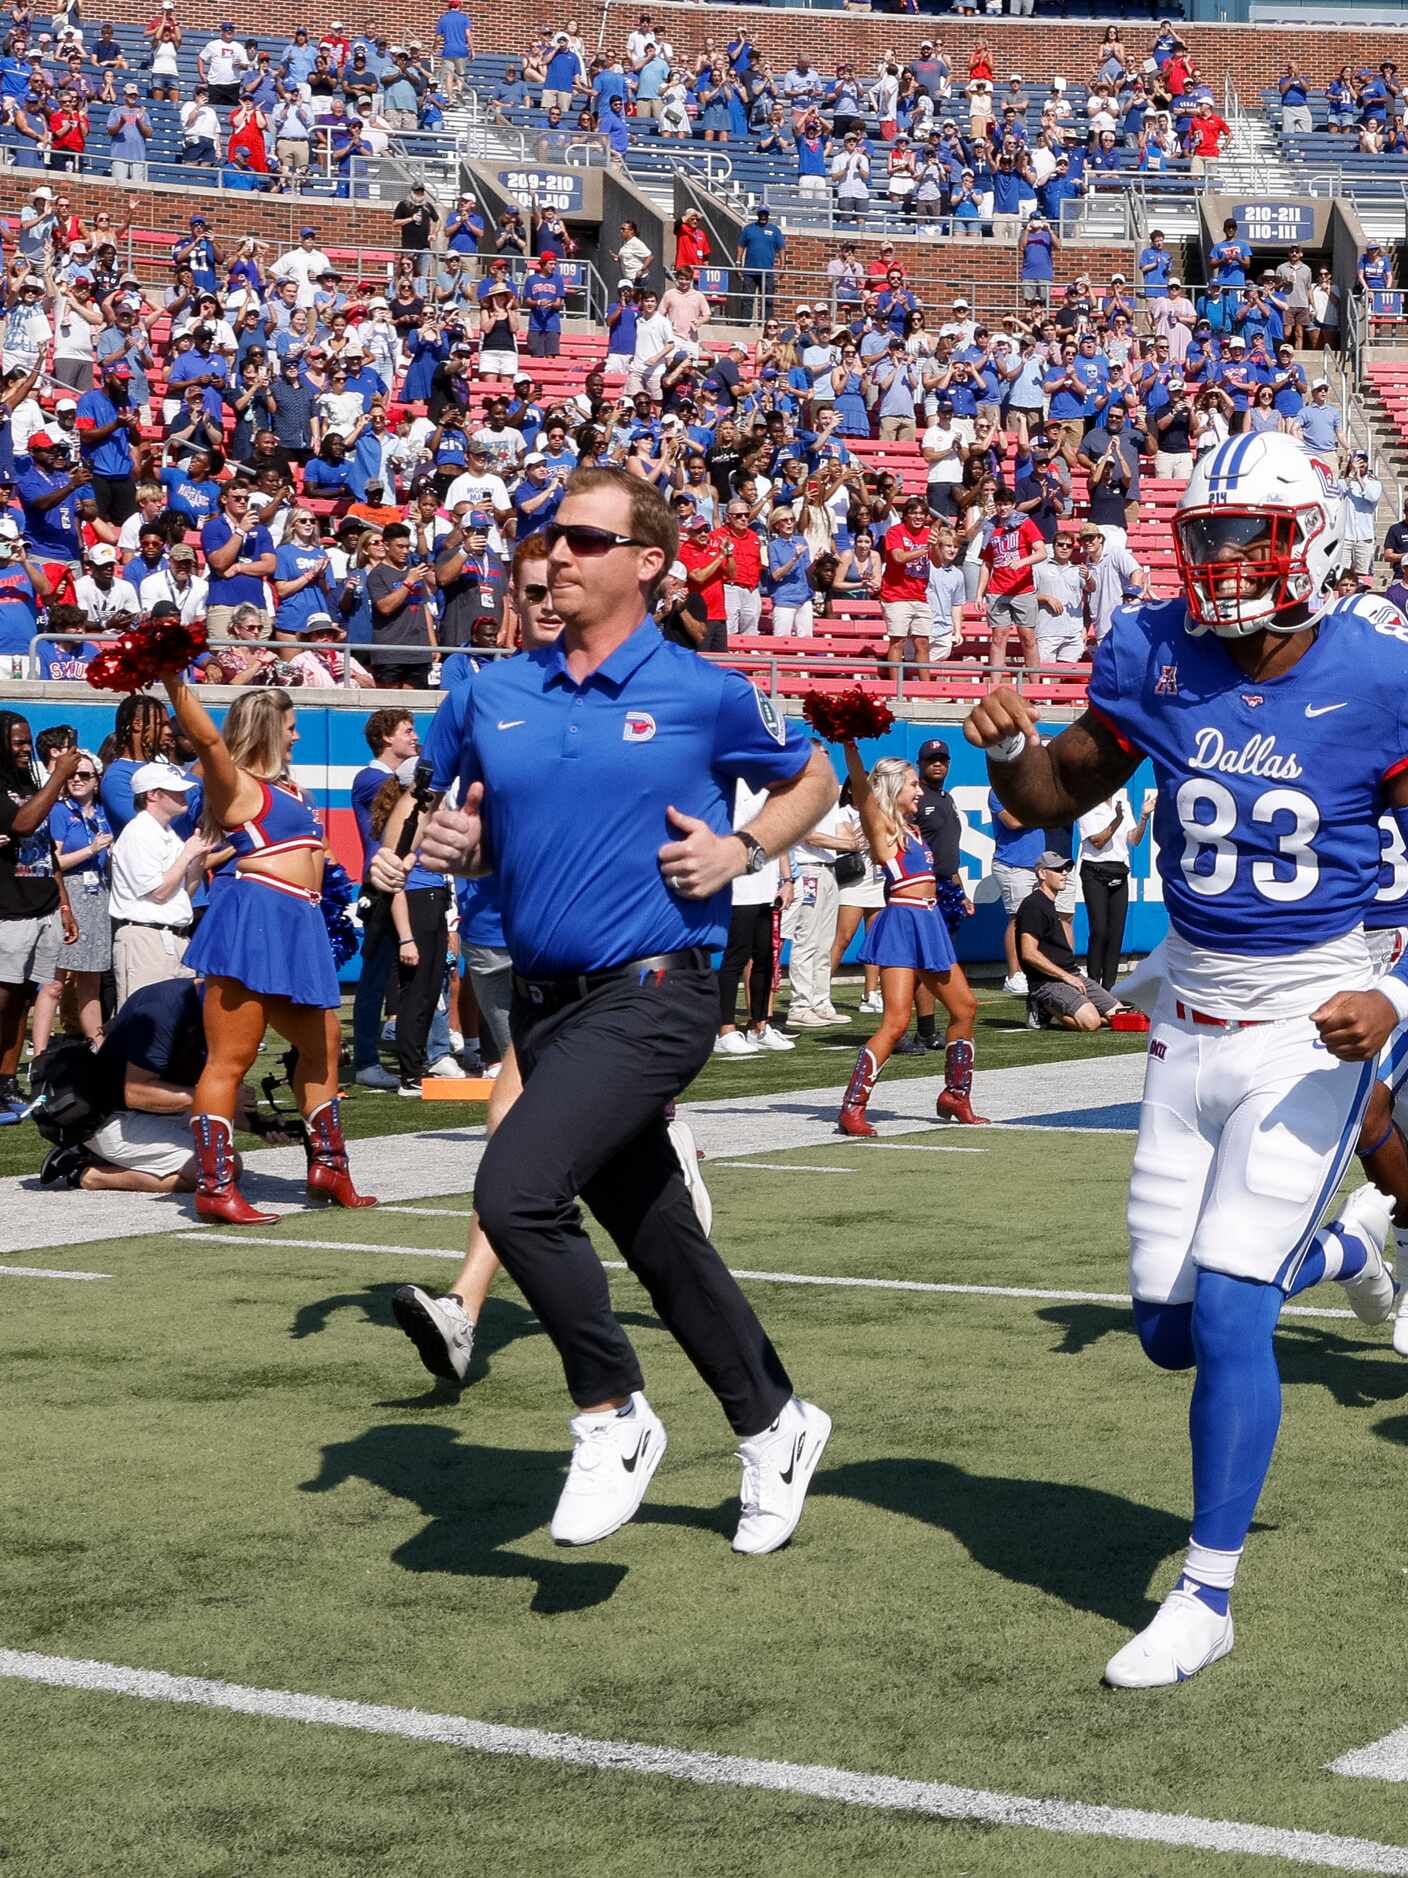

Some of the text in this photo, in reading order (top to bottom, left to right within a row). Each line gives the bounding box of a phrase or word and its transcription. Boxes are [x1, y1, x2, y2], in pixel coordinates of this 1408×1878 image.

[507, 173, 573, 191] 209-210
[1244, 207, 1302, 221] 210-211
[1248, 224, 1297, 240] 110-111
[559, 263, 577, 276] 109
[706, 270, 721, 282] 110
[1381, 293, 1393, 304] 111
[1208, 492, 1227, 504] 214
[50, 661, 89, 681] SMU
[1189, 726, 1303, 781] Dallas
[1179, 777, 1320, 901] 83
